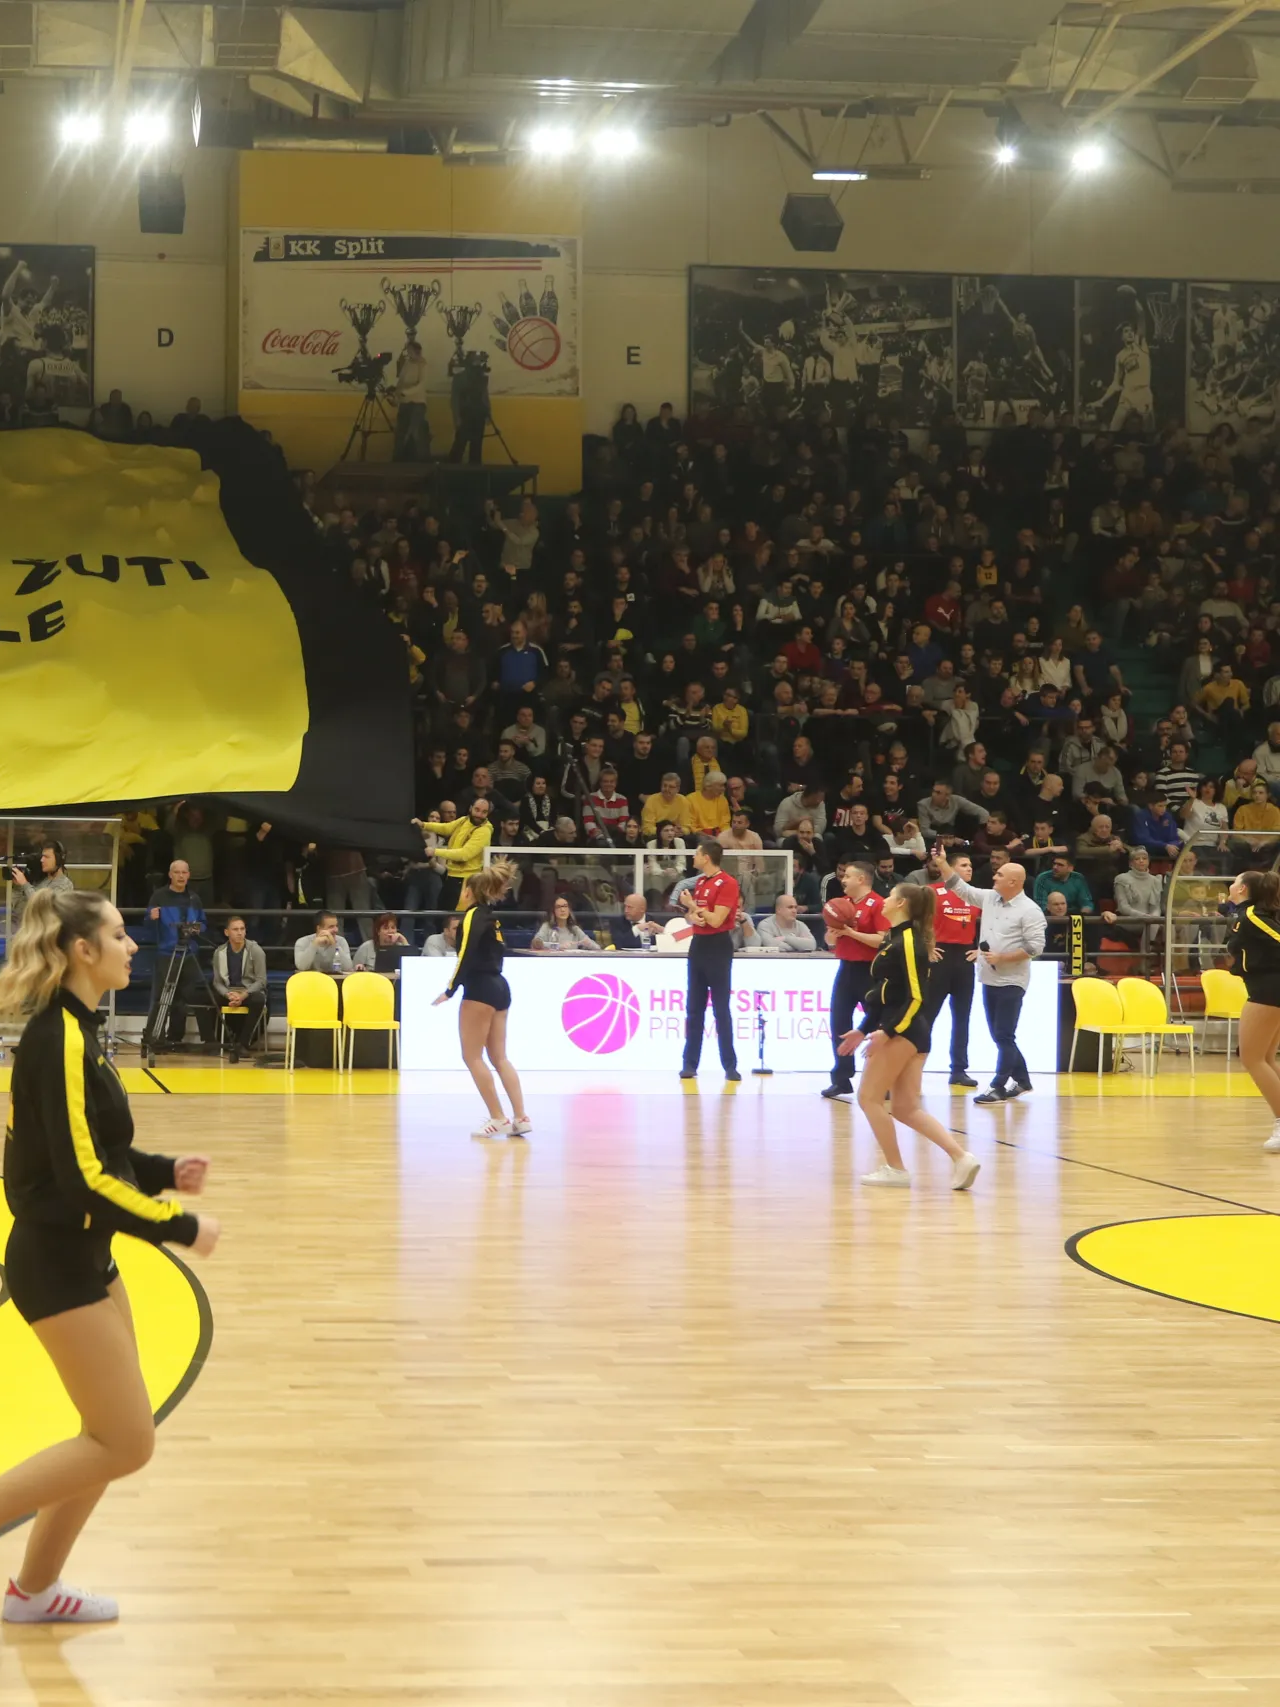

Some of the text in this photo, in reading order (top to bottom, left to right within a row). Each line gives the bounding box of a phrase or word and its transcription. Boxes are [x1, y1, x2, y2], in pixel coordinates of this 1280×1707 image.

[288, 237, 385, 259] KK Split
[156, 327, 175, 348] D
[261, 327, 344, 356] Coca-Cola
[626, 345, 642, 365] E
[1071, 917, 1083, 973] SPLIT
